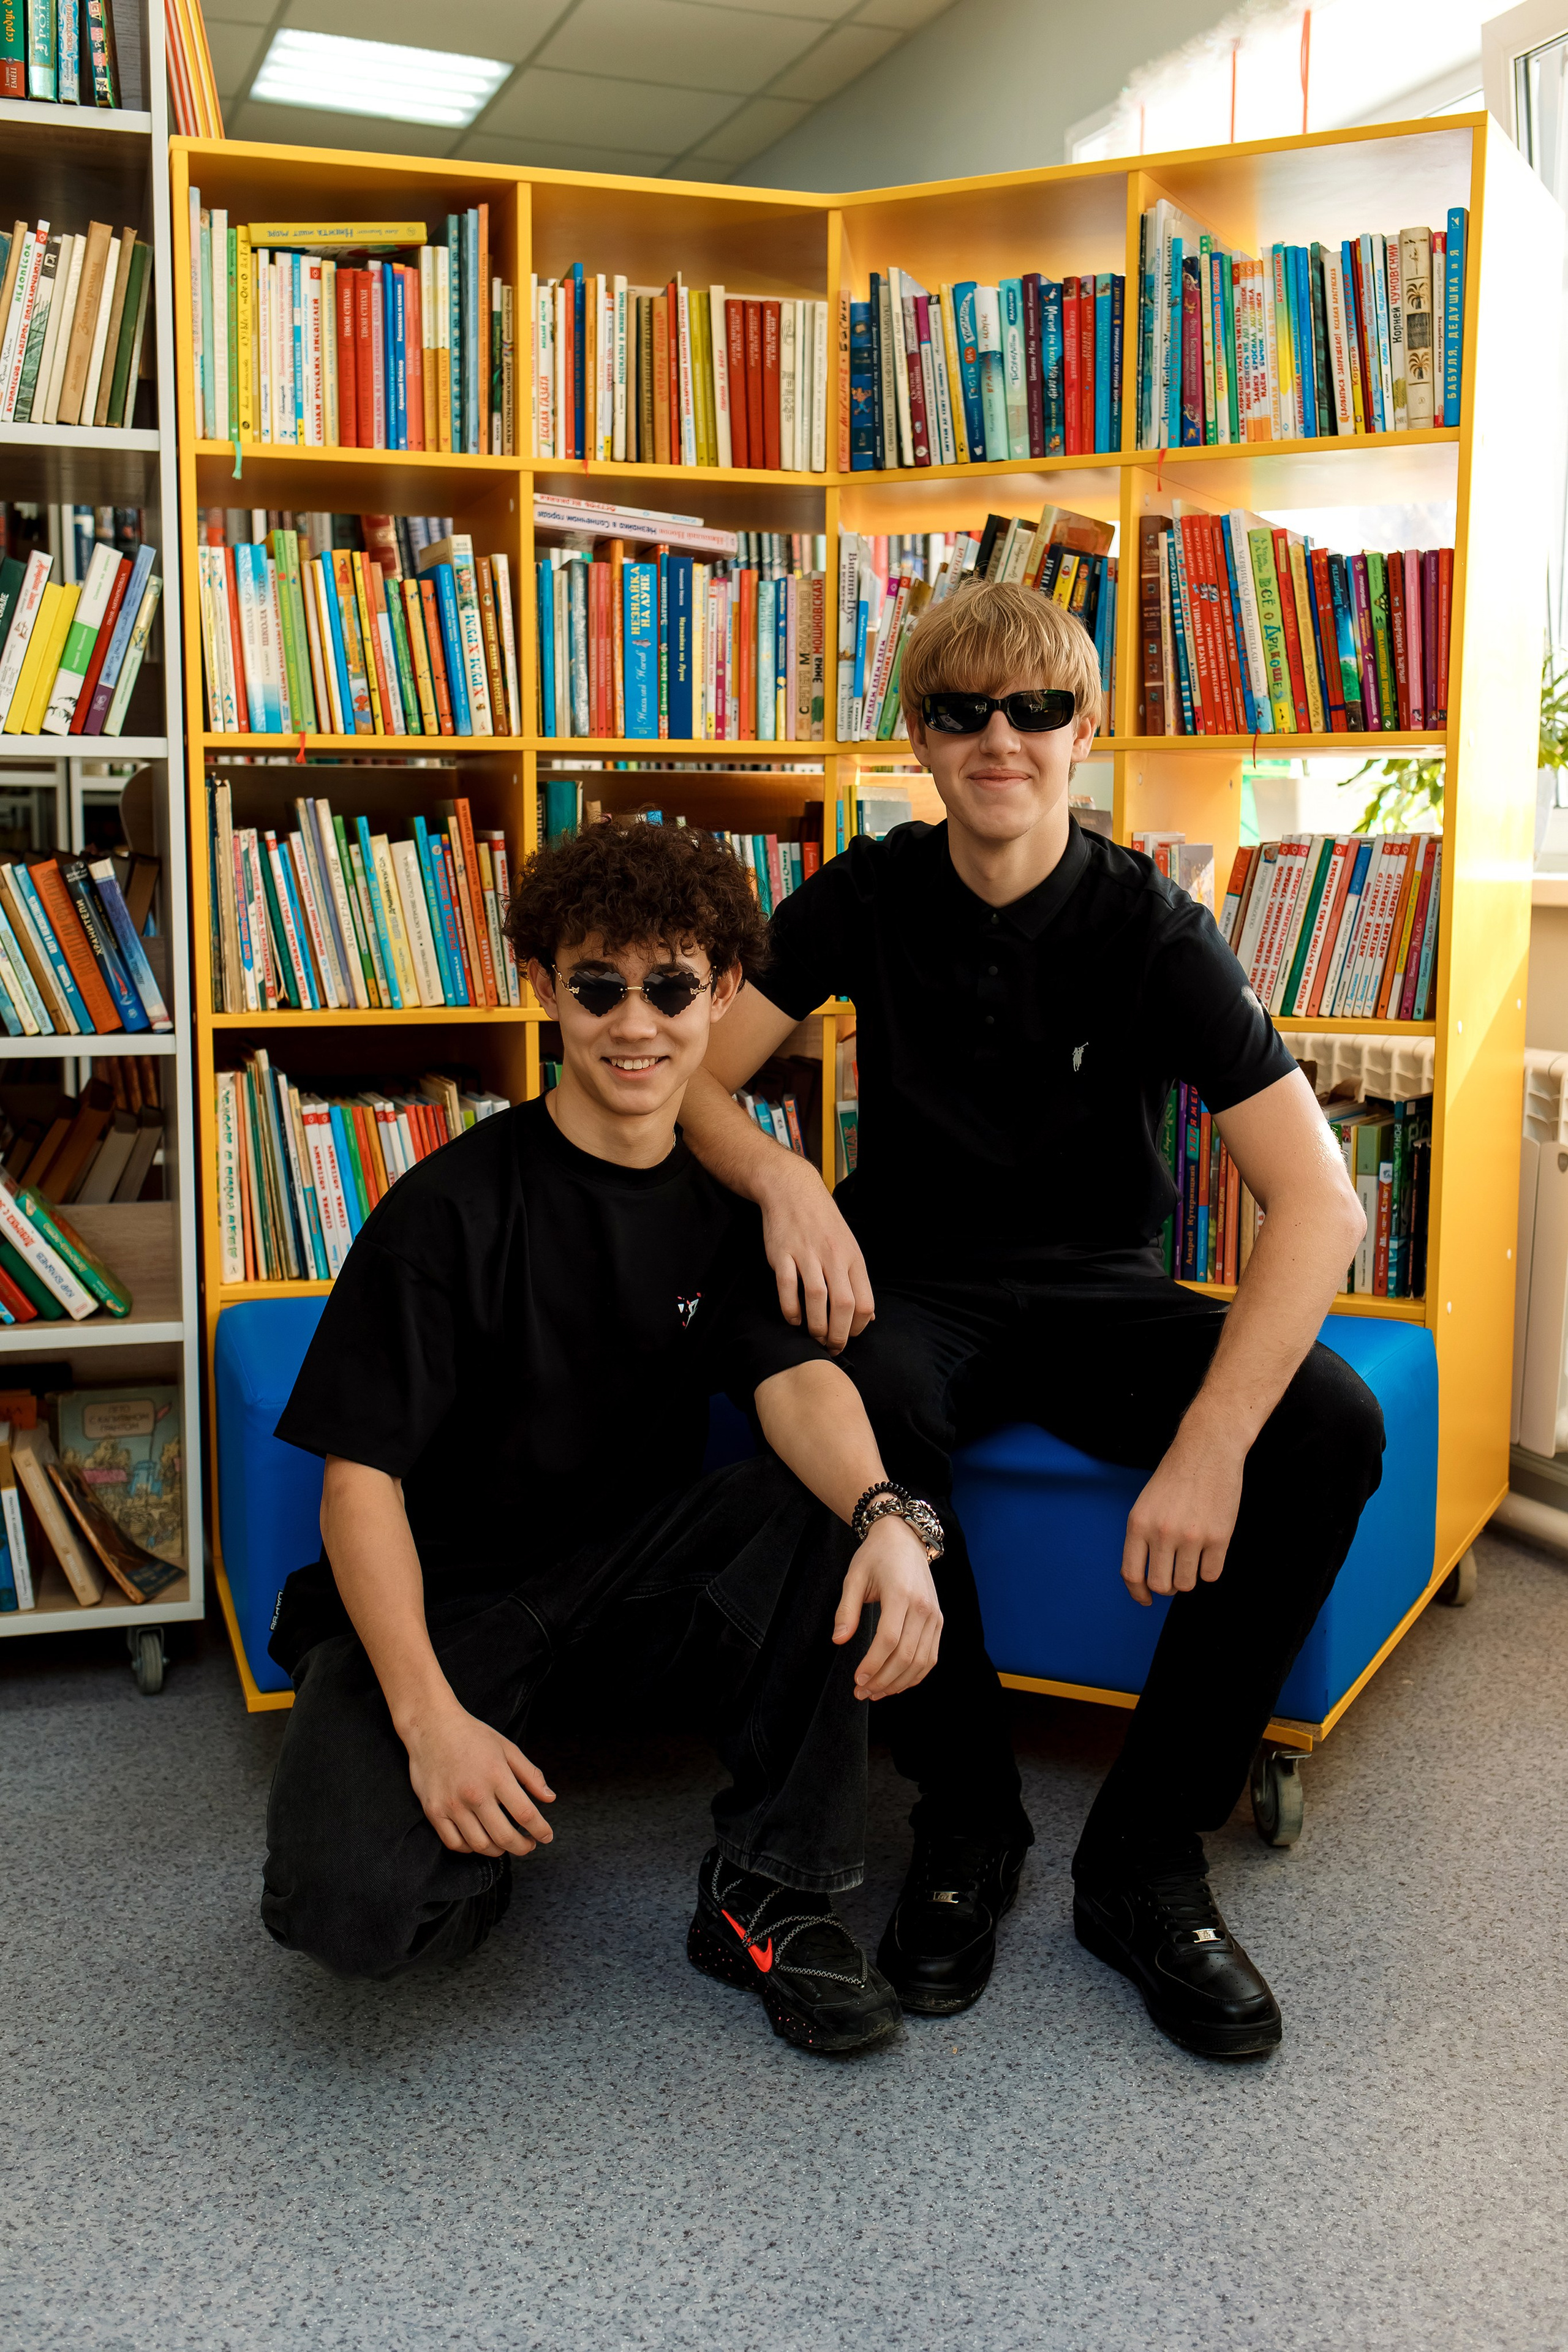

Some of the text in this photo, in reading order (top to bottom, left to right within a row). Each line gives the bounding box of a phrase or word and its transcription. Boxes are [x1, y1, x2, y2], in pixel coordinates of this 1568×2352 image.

[14, 244, 32, 301] НЕДОПЁСОК
[1210, 259, 1220, 295] СКАЗКУ!
[1275, 252, 1284, 303] БАРАБАШКА
[1387, 244, 1403, 343] Корней ЧУКОВСКИЙ
[6, 366, 21, 412] КУРОЛЕСОВ
[17, 323, 30, 355] МАТРОС
[24, 252, 43, 320] ПОДКЛЮЧАЮТСЯ
[312, 298, 320, 353] ПИСАТЕЛЕЙ
[1213, 304, 1223, 362] ПОЖАЛОВАТЬ
[1242, 328, 1249, 340] ДО
[1268, 323, 1275, 337] НА
[1343, 273, 1360, 386] Корней ЧУКОВСКИЙ
[1447, 277, 1459, 338] ДЕДУШКА
[1216, 364, 1224, 392] ДОБРО
[1269, 342, 1278, 380] МИШКУ
[1447, 345, 1458, 399] БАБУЛЯ,
[539, 376, 549, 407] ГАЗЕТА
[1270, 385, 1280, 433] УРОНИЛИ
[1295, 375, 1305, 424] БАРАБАШКА
[1336, 378, 1350, 423] ЦЕЛОВАТЬСЯ
[537, 511, 565, 521] городе
[567, 516, 610, 529] Солнечном
[619, 522, 657, 535] Незнайка
[628, 565, 641, 635] НЕЗНАЙКА
[846, 552, 857, 624] Винни-Пух
[1238, 549, 1251, 597] ГУЛЛИВЕРА
[1258, 577, 1276, 608] ВСЁ
[639, 574, 651, 628] НА ЛУНЕ
[1284, 607, 1296, 641] АЗБУКА
[464, 614, 484, 697] ХРУМ ХРУМ
[679, 652, 685, 662] на
[796, 590, 812, 715] СЕРГЕЙ МИХАЛКОВ
[812, 579, 823, 684] Эмма МОШКОВСКАЯ
[1245, 600, 1259, 663] ПУТЕШЕСТВИЯ
[1263, 624, 1283, 690] ДРАКОШЕ
[1376, 628, 1389, 679] ЭВКАЛИПТОВЫЙ
[677, 663, 687, 682] Луне
[864, 639, 887, 730] МЫ ЕДЕМ ЕДЕМ ЕДЕМ
[878, 655, 893, 697] ПРАЗДНИК
[435, 859, 449, 900] ЗВЕРЯТА
[782, 850, 790, 876] Остер
[76, 899, 104, 956] ХРАНИТЕЛИ
[331, 858, 355, 949] ЗОЛОТЫЕ РУКИ
[1254, 865, 1284, 964] НЕВЫУЧЕННЫХ УРОКОВ
[1264, 902, 1284, 964] НЕВЫУЧЕННЫХ
[1280, 865, 1294, 899] УРОКОВ
[1358, 872, 1384, 957] МЯГКИЙ ХАРАКТЕР
[1368, 873, 1393, 959] МЯГКИЙ ХАРАКТЕР
[445, 914, 457, 950] РЕБЯТА
[1264, 867, 1303, 1000] СТРАНЕ НЕВЫУЧЕННЫХ УРОКОВ
[1296, 859, 1339, 1010] ВЕЧЕРА НА ХУТОРЕ БЛИЗ ДИКАНЬКИ
[313, 1145, 334, 1229] СТАРИК ХОТТАБЫЧ
[7, 1214, 36, 1248] Девочка
[1186, 1164, 1197, 1265] Андрей Кутерницкий
[36, 1253, 64, 1284] БУЛЫЧЕВ
[60, 1284, 75, 1298] КИР
